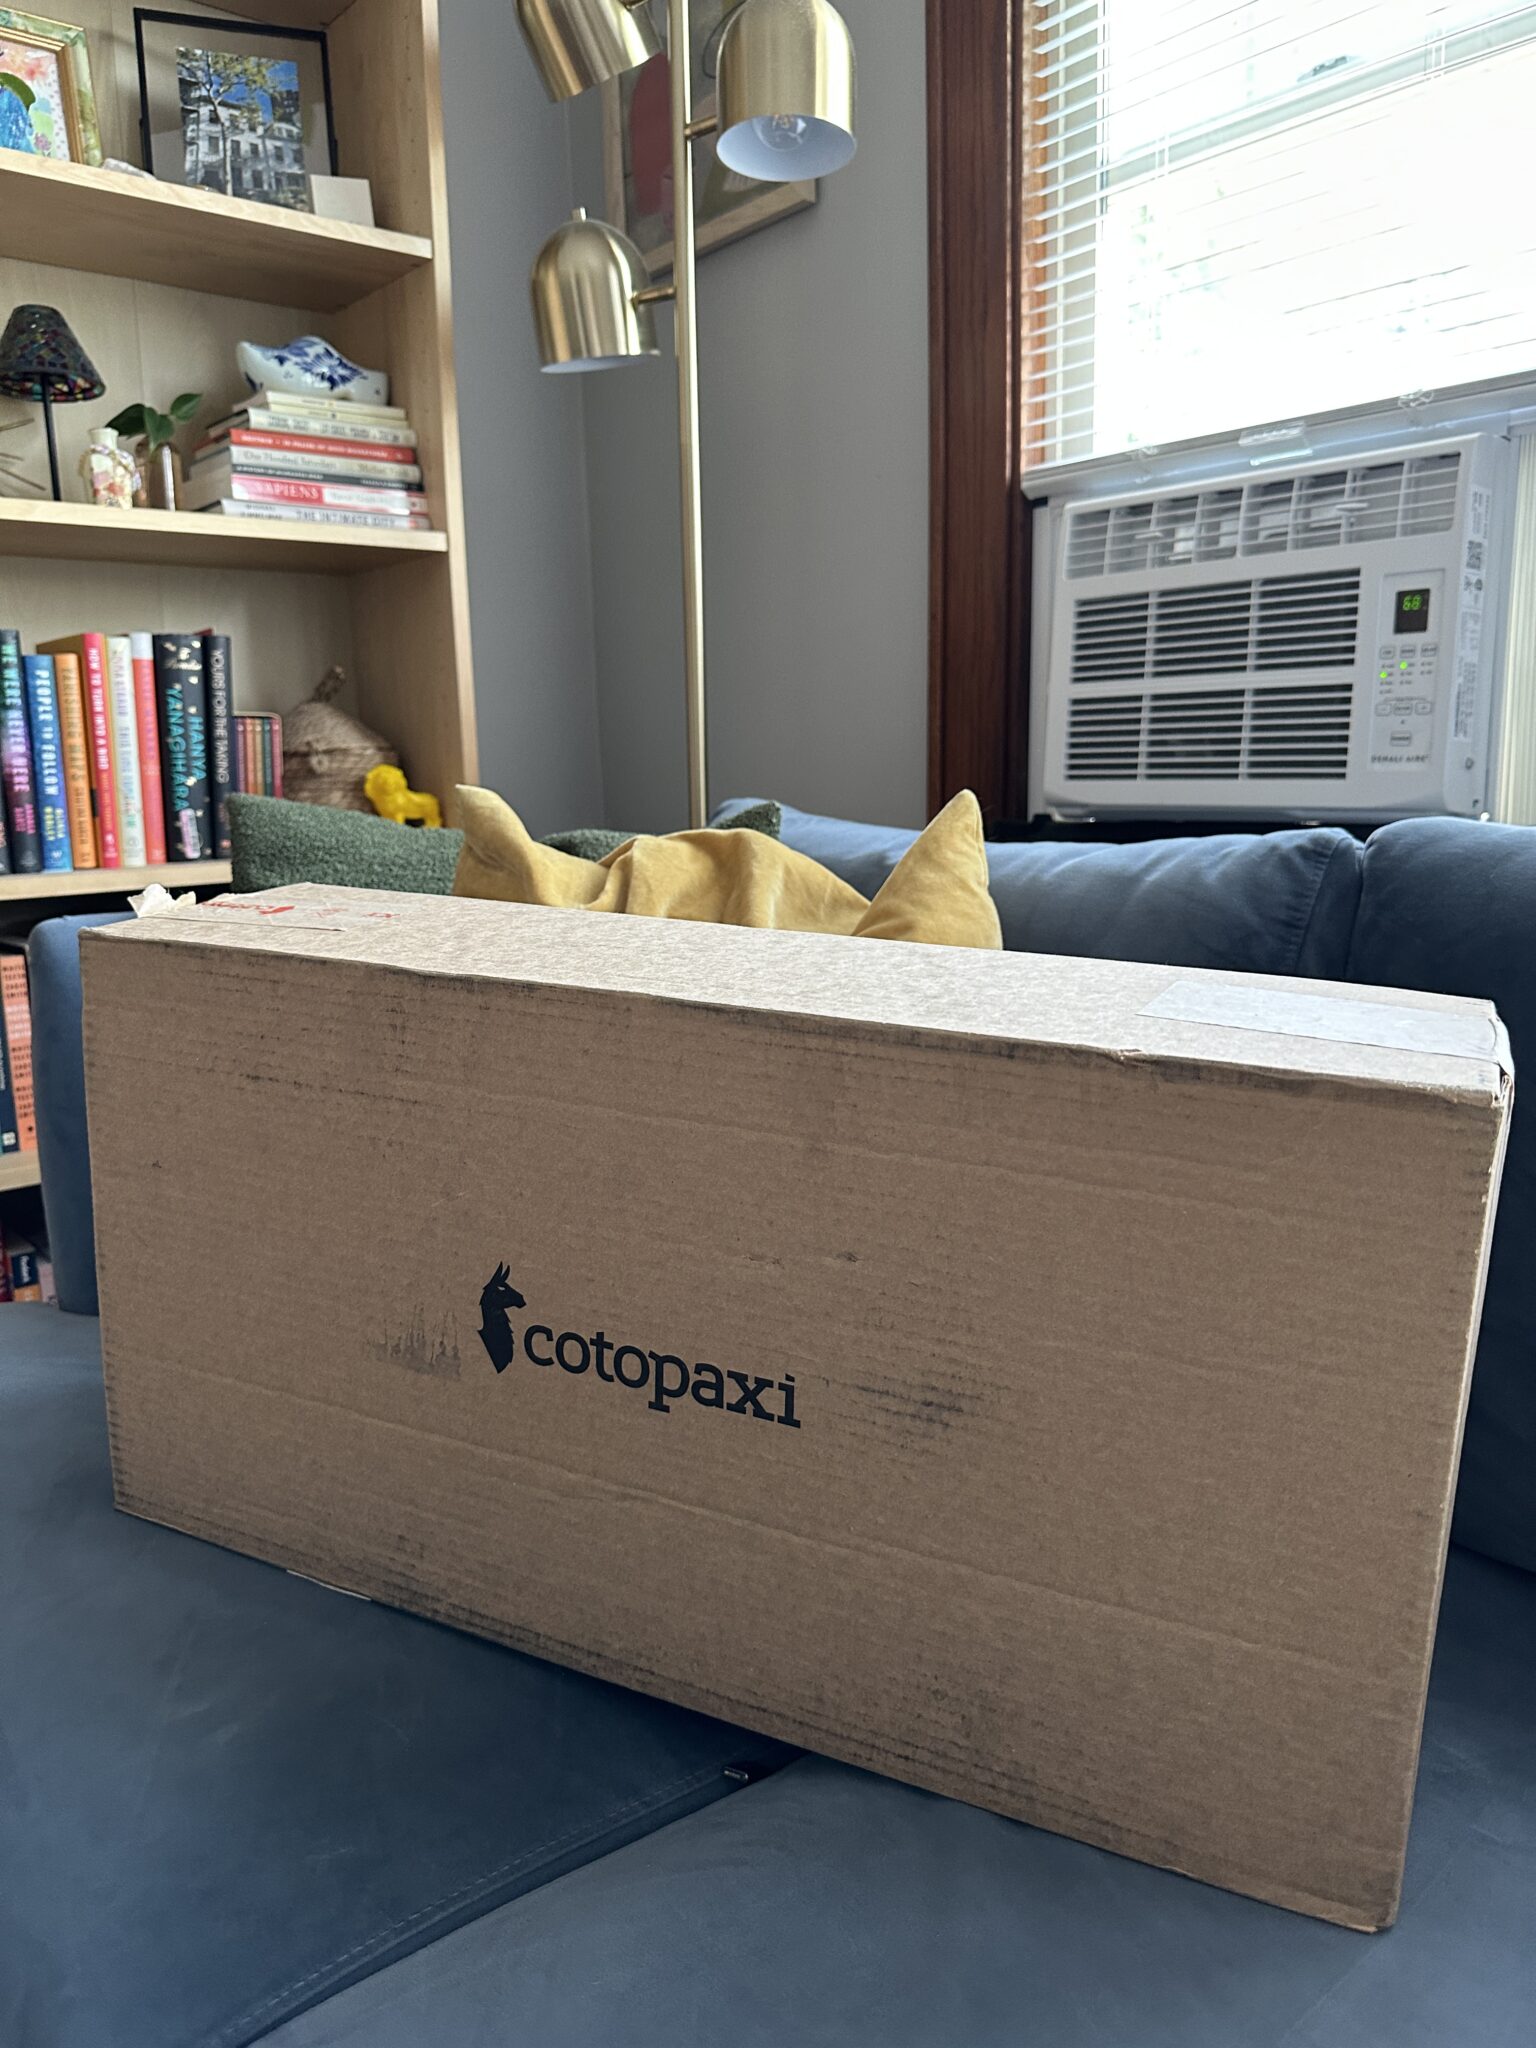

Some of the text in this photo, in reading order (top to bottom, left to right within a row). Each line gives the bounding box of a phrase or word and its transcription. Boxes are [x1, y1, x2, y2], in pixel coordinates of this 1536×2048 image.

[253, 481, 320, 500] SAPIENS
[1402, 594, 1422, 611] 68
[88, 648, 100, 671] HOW
[211, 650, 225, 689] YOURS
[90, 673, 102, 687] TO
[91, 688, 104, 713] TURN
[212, 689, 227, 717] FOR
[1, 643, 31, 793] WE WERE NEVER HERE
[94, 714, 107, 737] INTO
[214, 717, 229, 739] THE
[34, 669, 59, 796] PEOPLE TO FOLLOW
[96, 737, 107, 746] A
[96, 748, 109, 770] BIRD
[165, 688, 190, 812] YANAGIHARA
[187, 716, 207, 780] HANYA
[214, 739, 230, 784] TAKING
[524, 1324, 801, 1429] cotopaxi
